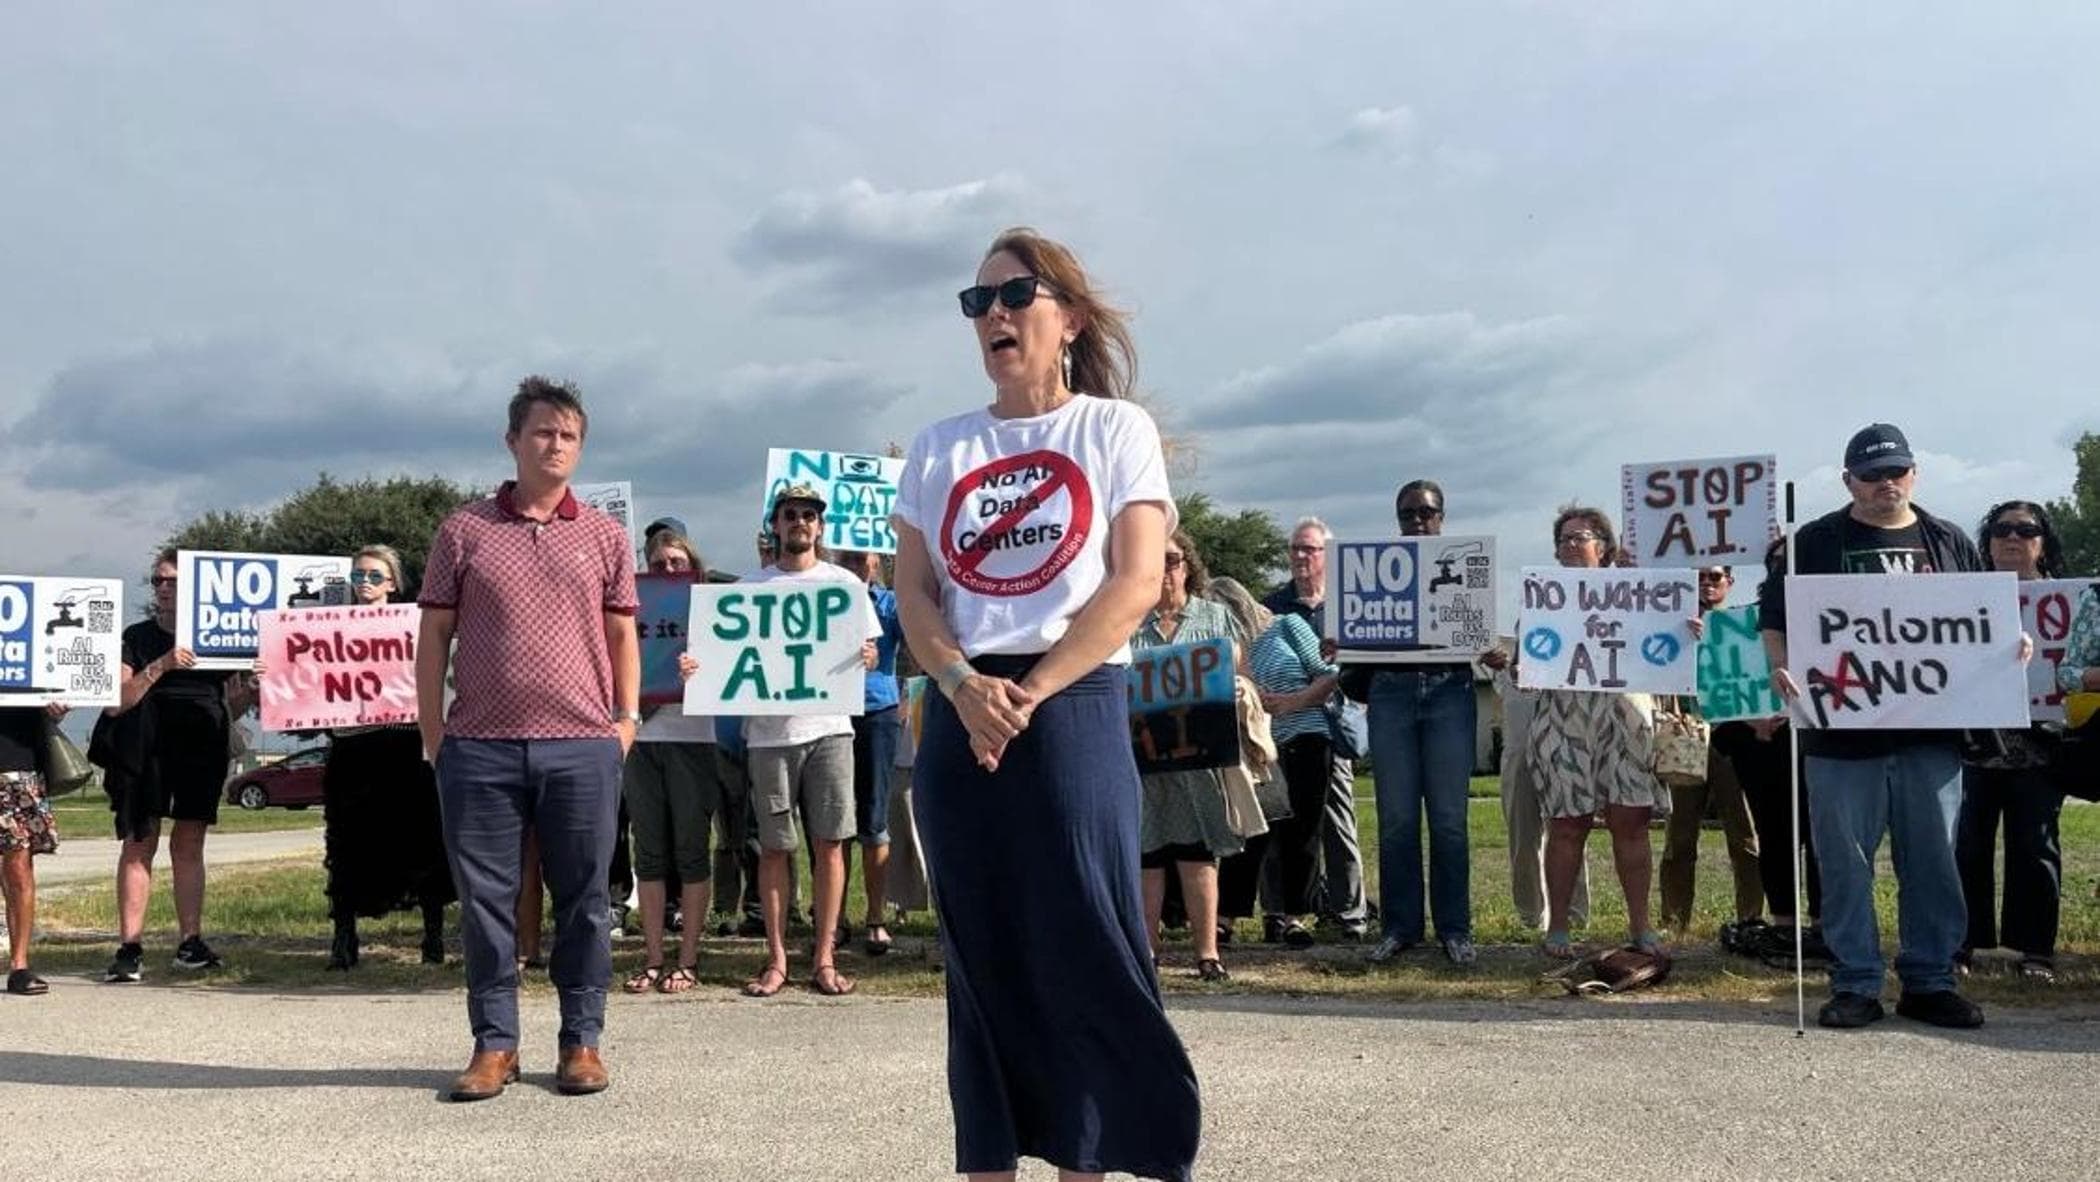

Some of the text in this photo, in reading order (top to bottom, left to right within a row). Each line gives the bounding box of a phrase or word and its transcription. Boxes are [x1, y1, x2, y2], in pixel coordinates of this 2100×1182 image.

[981, 472, 1017, 490] No
[832, 482, 897, 515] DAT
[979, 494, 1041, 518] Data
[958, 523, 1064, 553] Centers
[1654, 508, 1746, 557] A.I.
[198, 559, 273, 606] NO
[1343, 545, 1415, 593] NO
[712, 587, 849, 642] STOP
[1343, 593, 1414, 621] Data
[1343, 621, 1414, 639] Centers
[1584, 613, 1623, 638] for
[1819, 607, 1991, 645] Palomi
[286, 631, 414, 663] Palomi
[1566, 640, 1628, 687] AI
[324, 671, 382, 703] NO
[720, 644, 829, 701] A.I.
[1127, 646, 1219, 704] TOP
